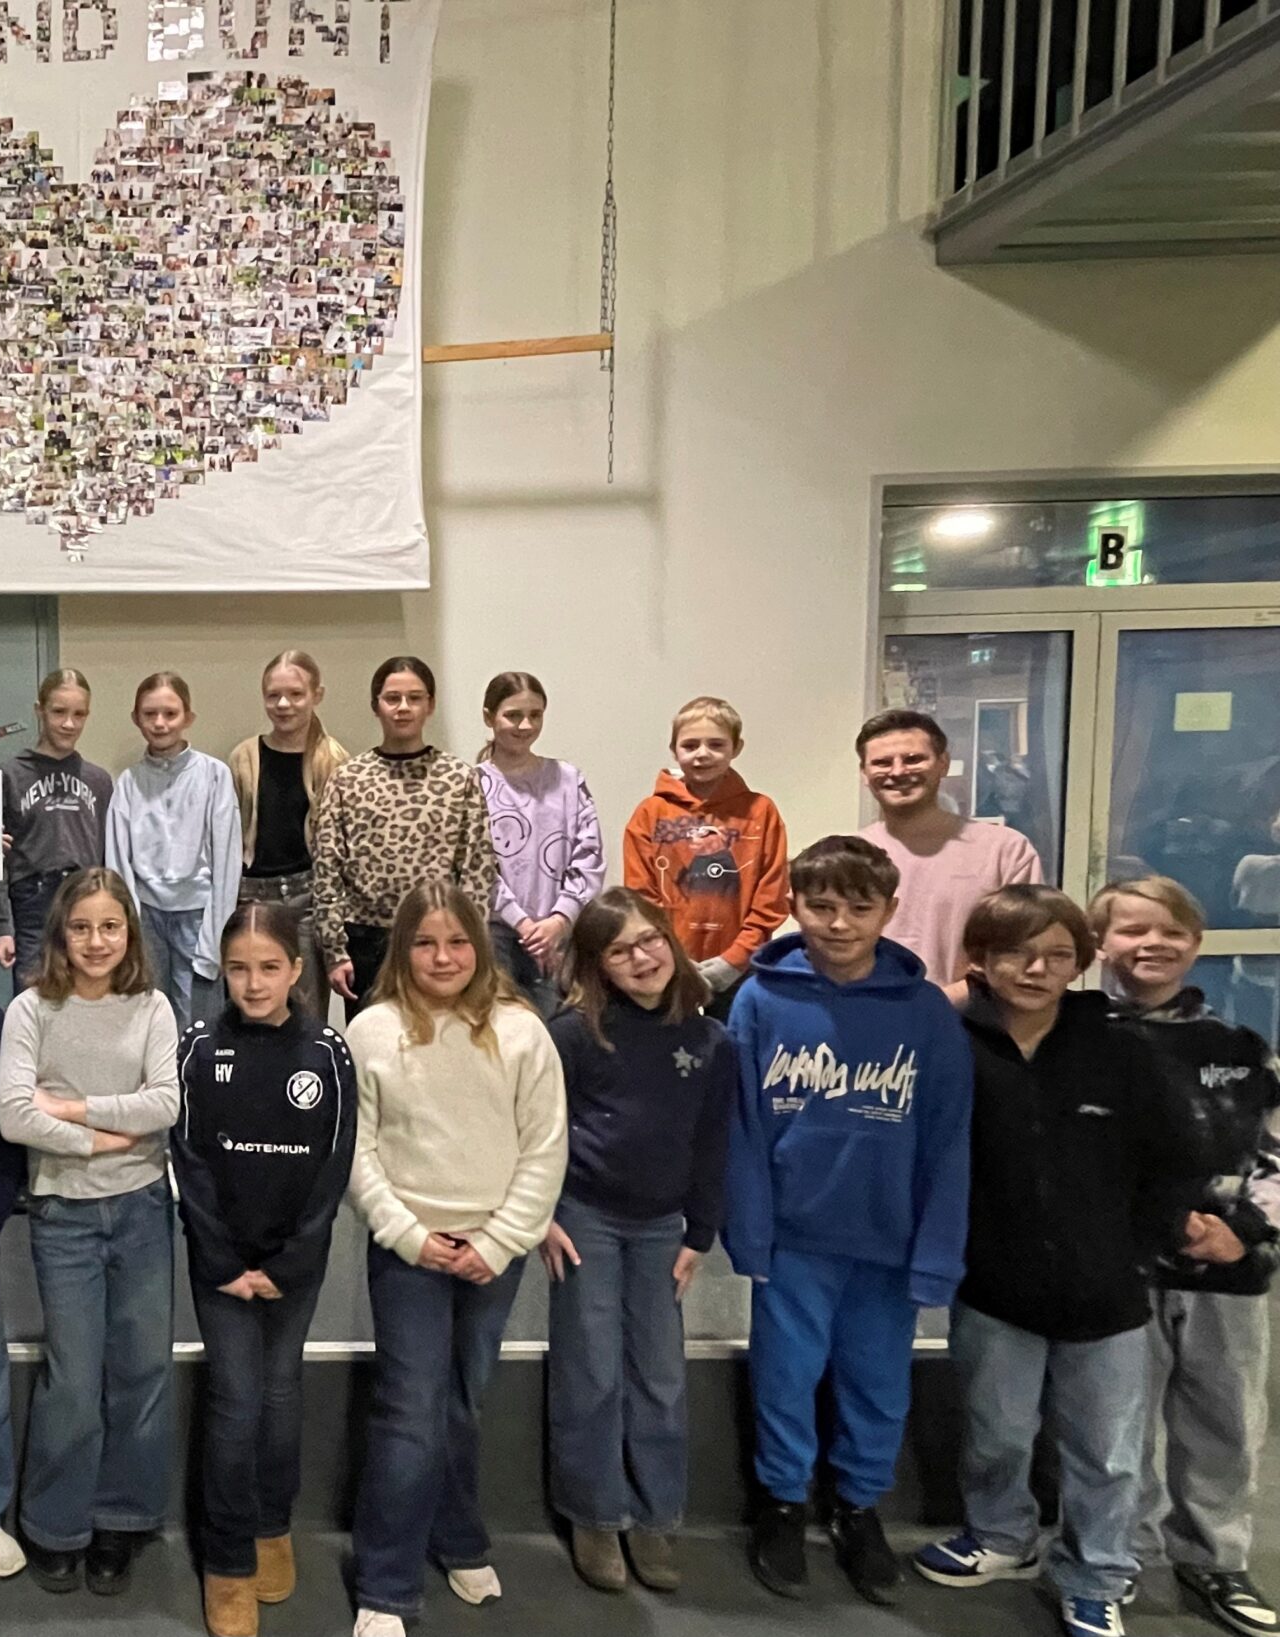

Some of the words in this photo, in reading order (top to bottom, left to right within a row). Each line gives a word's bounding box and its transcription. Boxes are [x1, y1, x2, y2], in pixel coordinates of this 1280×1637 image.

[147, 0, 410, 64] BUNT
[1100, 533, 1125, 570] B
[215, 1063, 234, 1083] HV
[233, 1142, 310, 1155] ACTEMIUM
